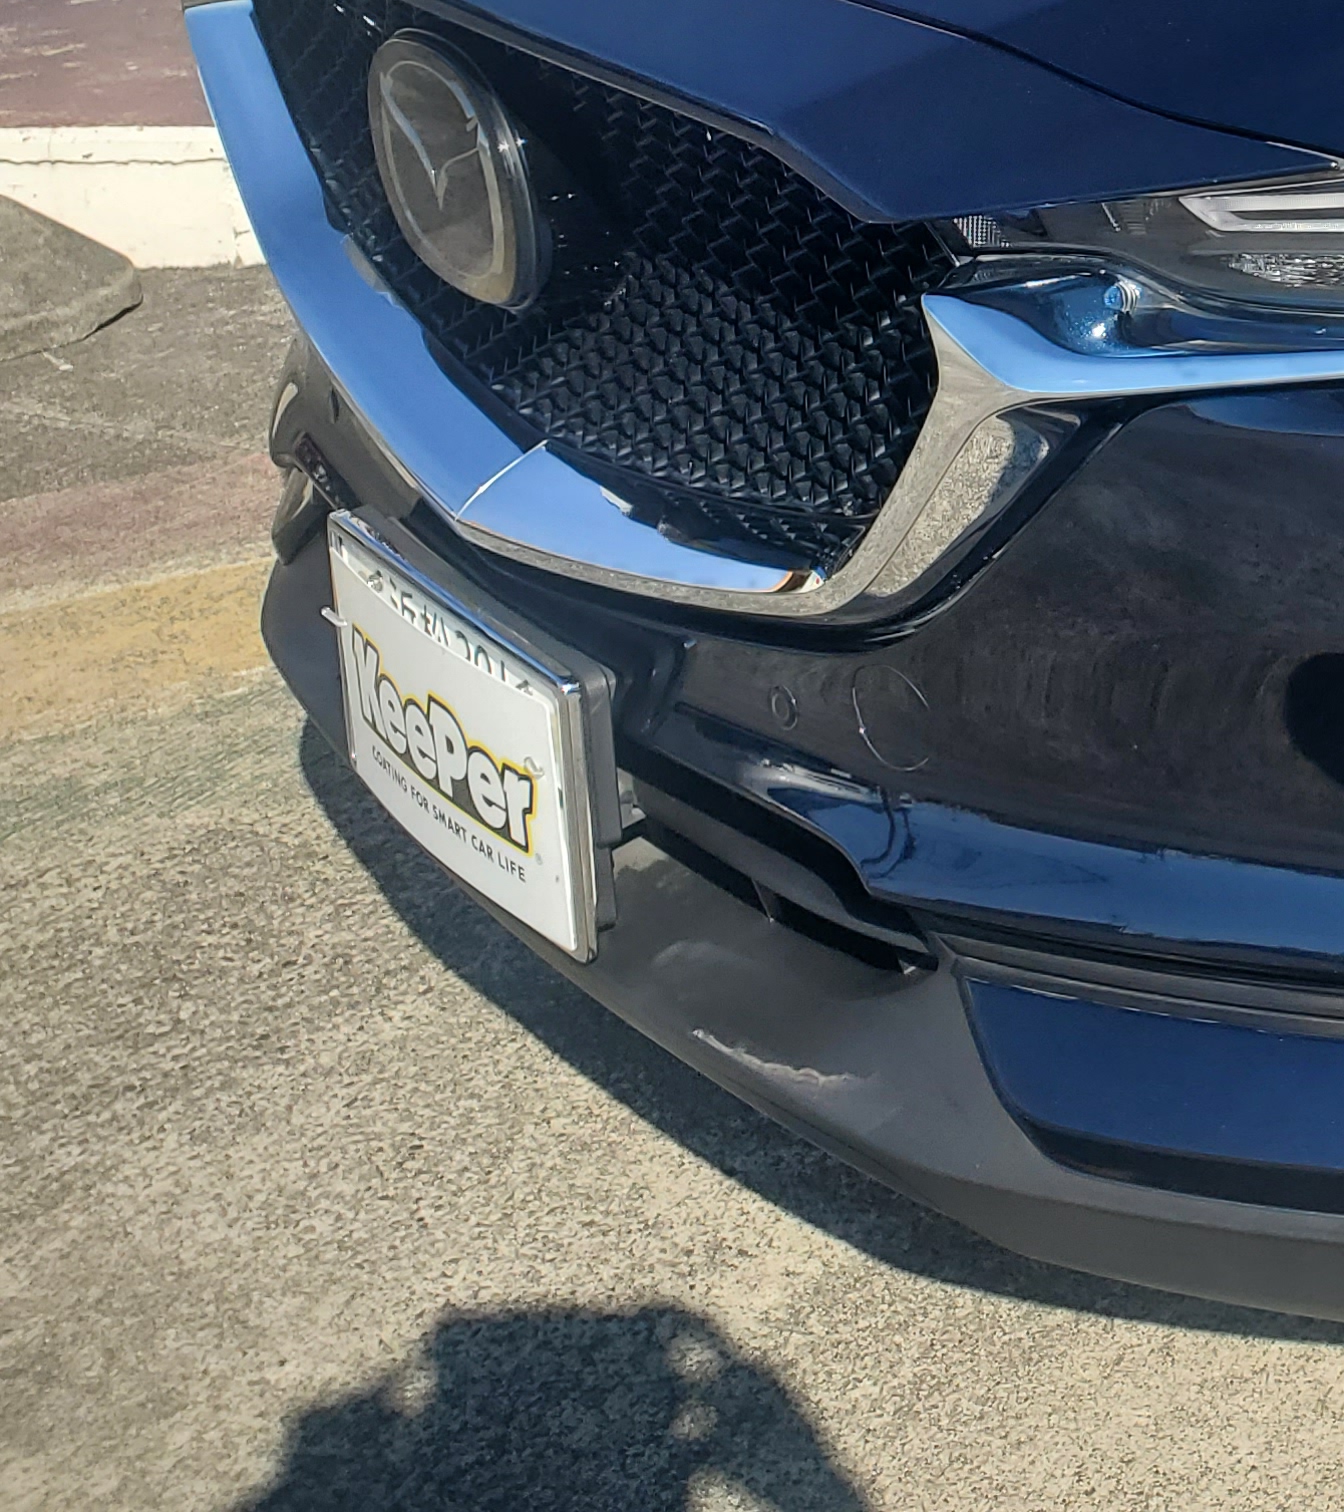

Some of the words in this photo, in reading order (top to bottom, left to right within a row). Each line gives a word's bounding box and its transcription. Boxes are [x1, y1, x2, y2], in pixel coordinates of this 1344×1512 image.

[351, 622, 537, 855] KeePer
[372, 745, 408, 792] COATING
[411, 786, 429, 815] FOR
[432, 804, 468, 844] SMART
[471, 834, 494, 862] CAR
[498, 853, 526, 882] LIFE
